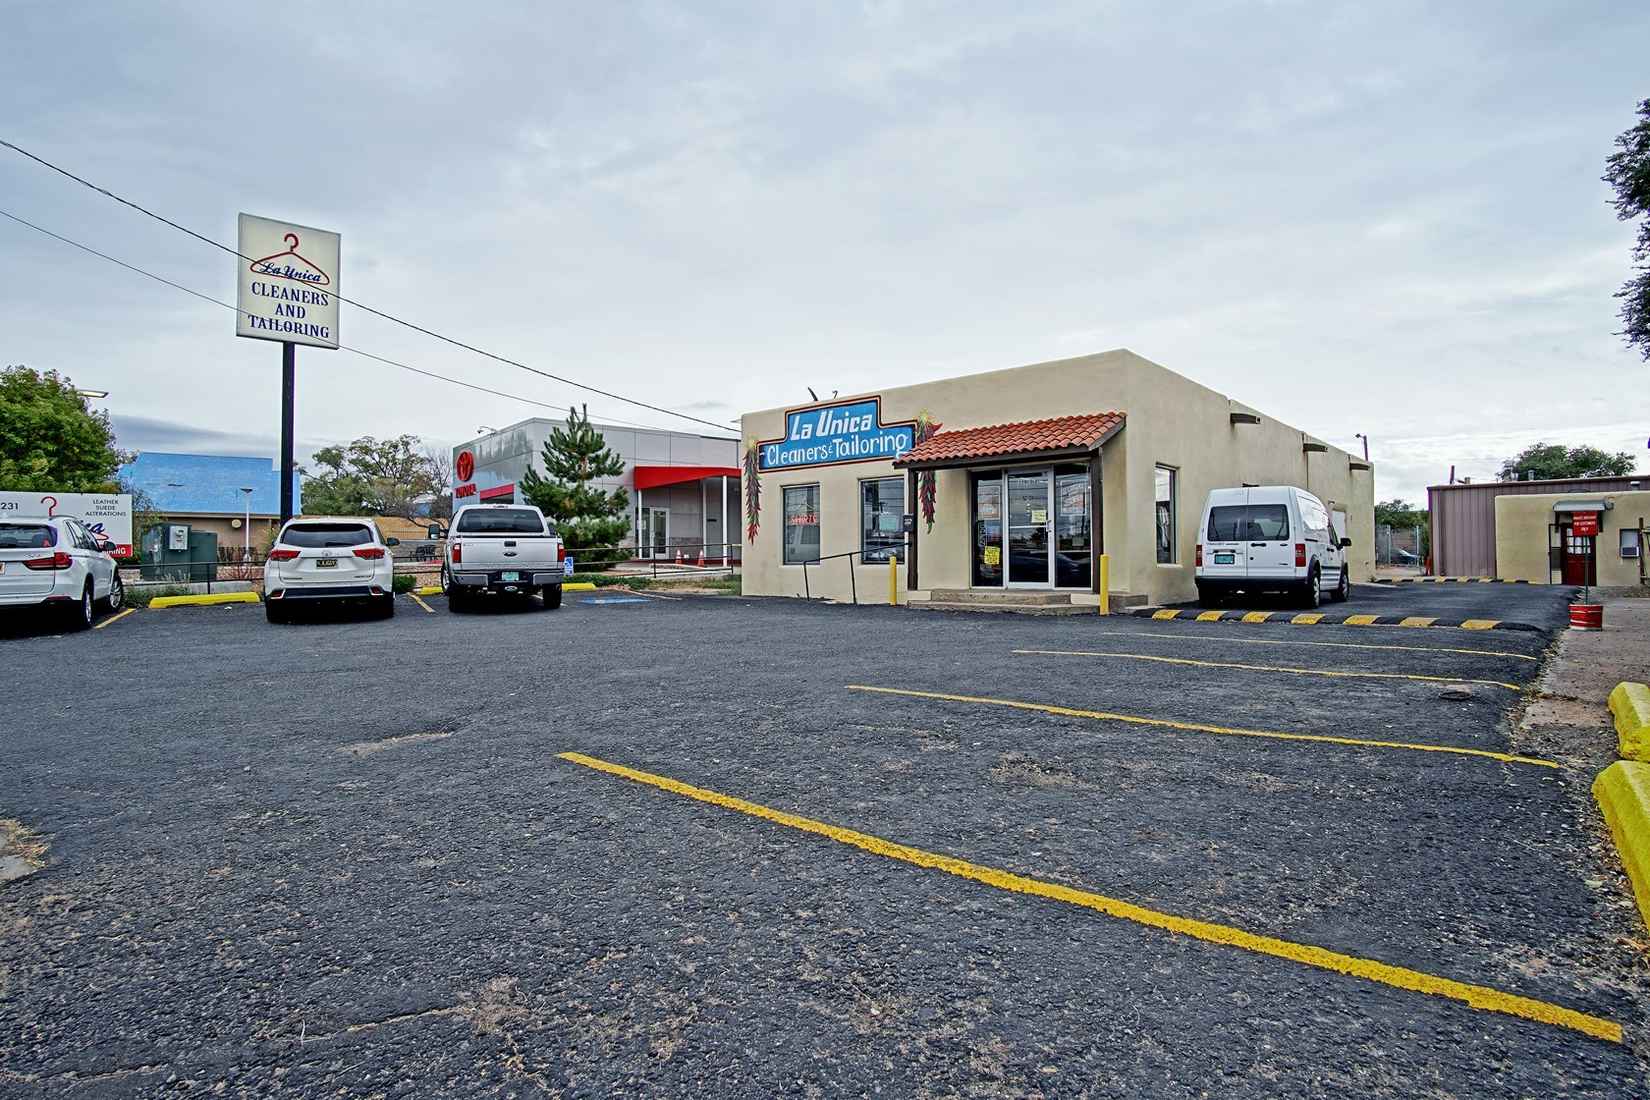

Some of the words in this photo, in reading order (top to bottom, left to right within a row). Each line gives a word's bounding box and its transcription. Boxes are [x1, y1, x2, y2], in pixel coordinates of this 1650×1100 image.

[260, 262, 281, 274] La
[283, 265, 322, 282] Unica
[251, 281, 329, 306] CLEANERS
[275, 303, 306, 319] AND
[247, 314, 329, 338] TAILORING
[789, 415, 813, 441] La
[815, 410, 873, 437] Unica
[767, 444, 828, 466] Cleaners
[832, 430, 909, 460] Tailoring
